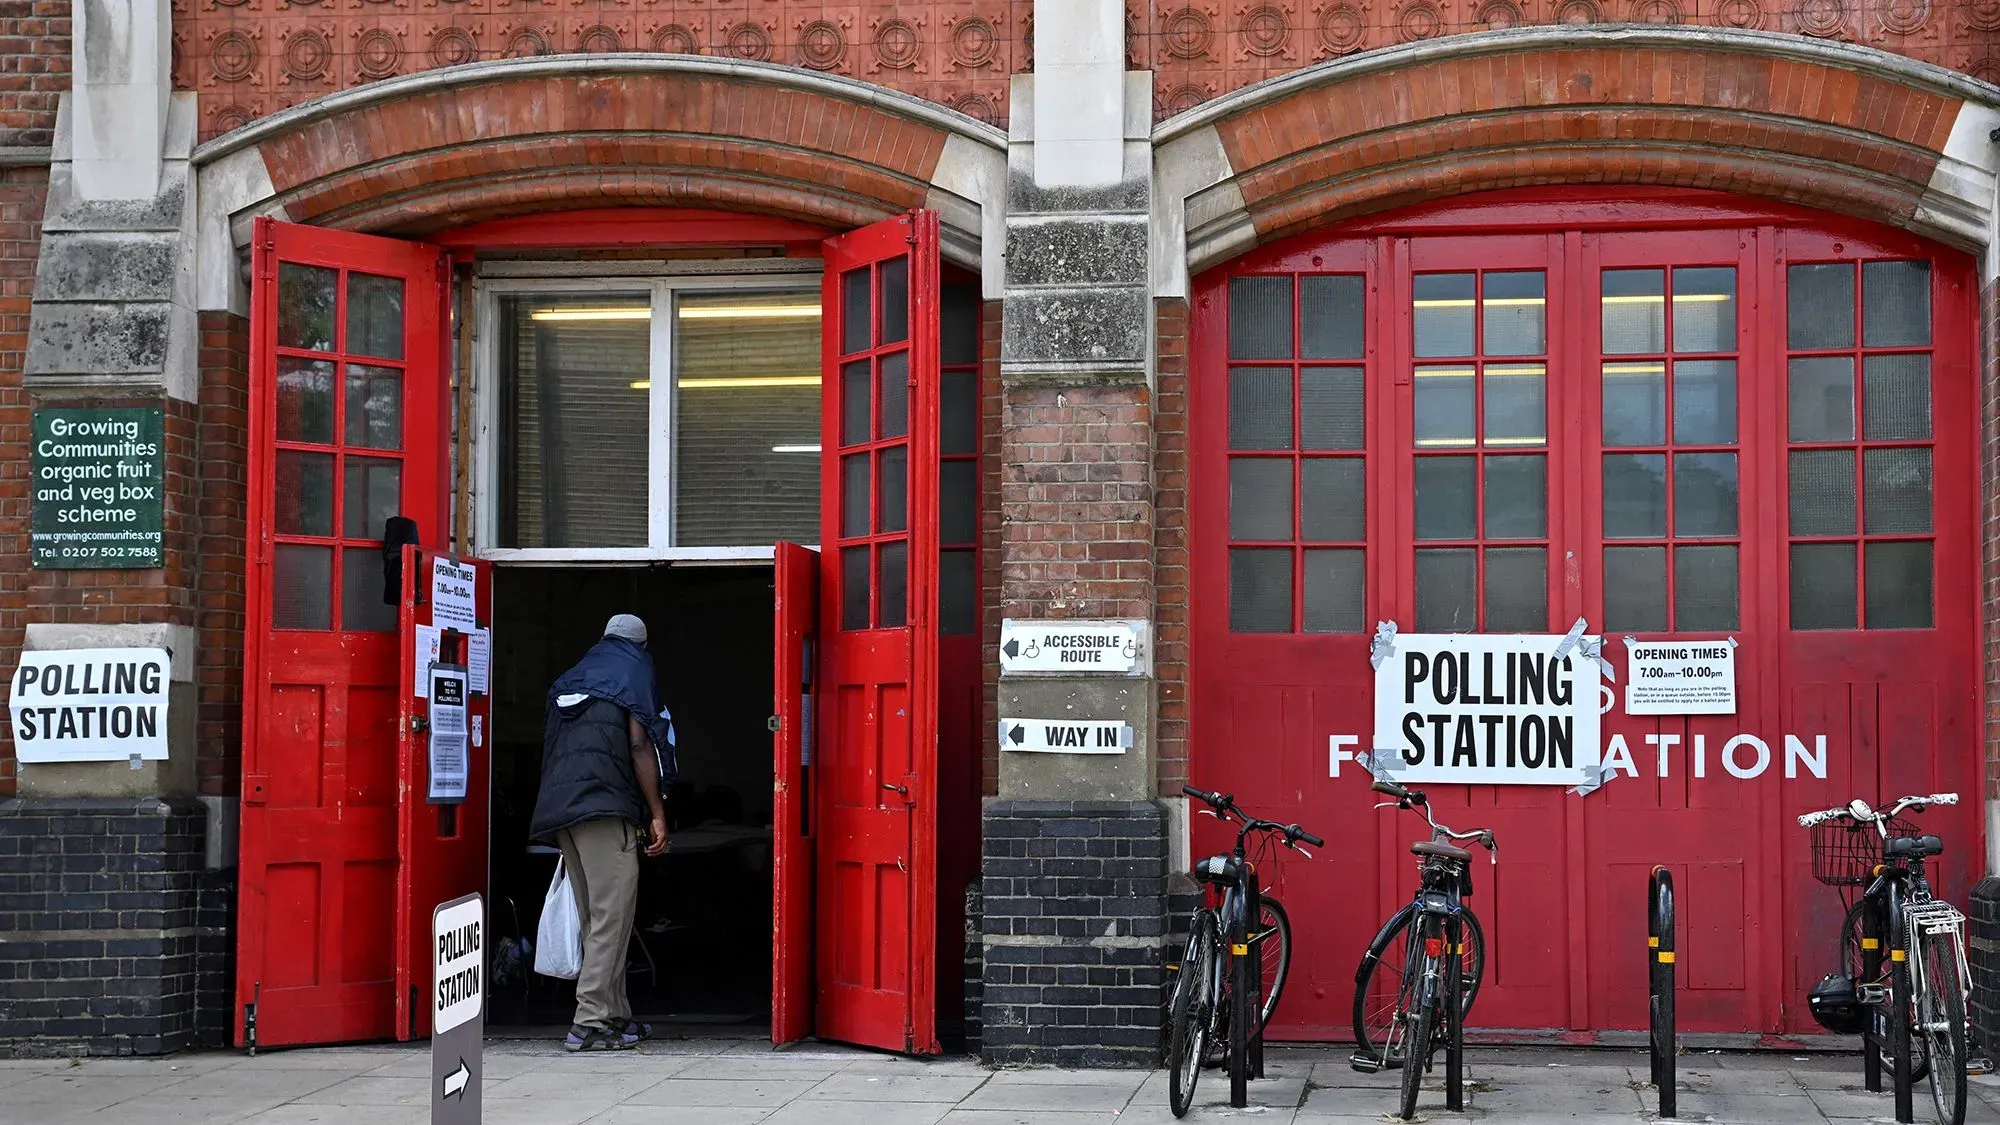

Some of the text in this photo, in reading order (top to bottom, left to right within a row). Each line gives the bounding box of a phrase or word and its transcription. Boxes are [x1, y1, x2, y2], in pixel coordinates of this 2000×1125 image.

[50, 418, 138, 439] Growing
[38, 440, 157, 457] Communities
[41, 460, 152, 483] organic fruit
[37, 482, 154, 504] and veg box
[57, 505, 137, 522] scheme
[32, 529, 161, 543] www.growingcommunities.org
[38, 547, 157, 557] Tel. 0207 502 7588
[435, 563, 473, 582] OPENING TIMES
[1043, 635, 1120, 648] ACCESSIBLE
[1060, 650, 1101, 663] ROUTE
[1634, 648, 1728, 660] OPENING TIMES
[18, 662, 161, 697] POLLING
[1405, 650, 1573, 706] POLLING
[19, 705, 157, 741] STATION
[1045, 726, 1117, 747] WAY IN
[1401, 712, 1573, 769] STATION
[438, 920, 480, 966] POLLING
[438, 964, 480, 1012] STATION
